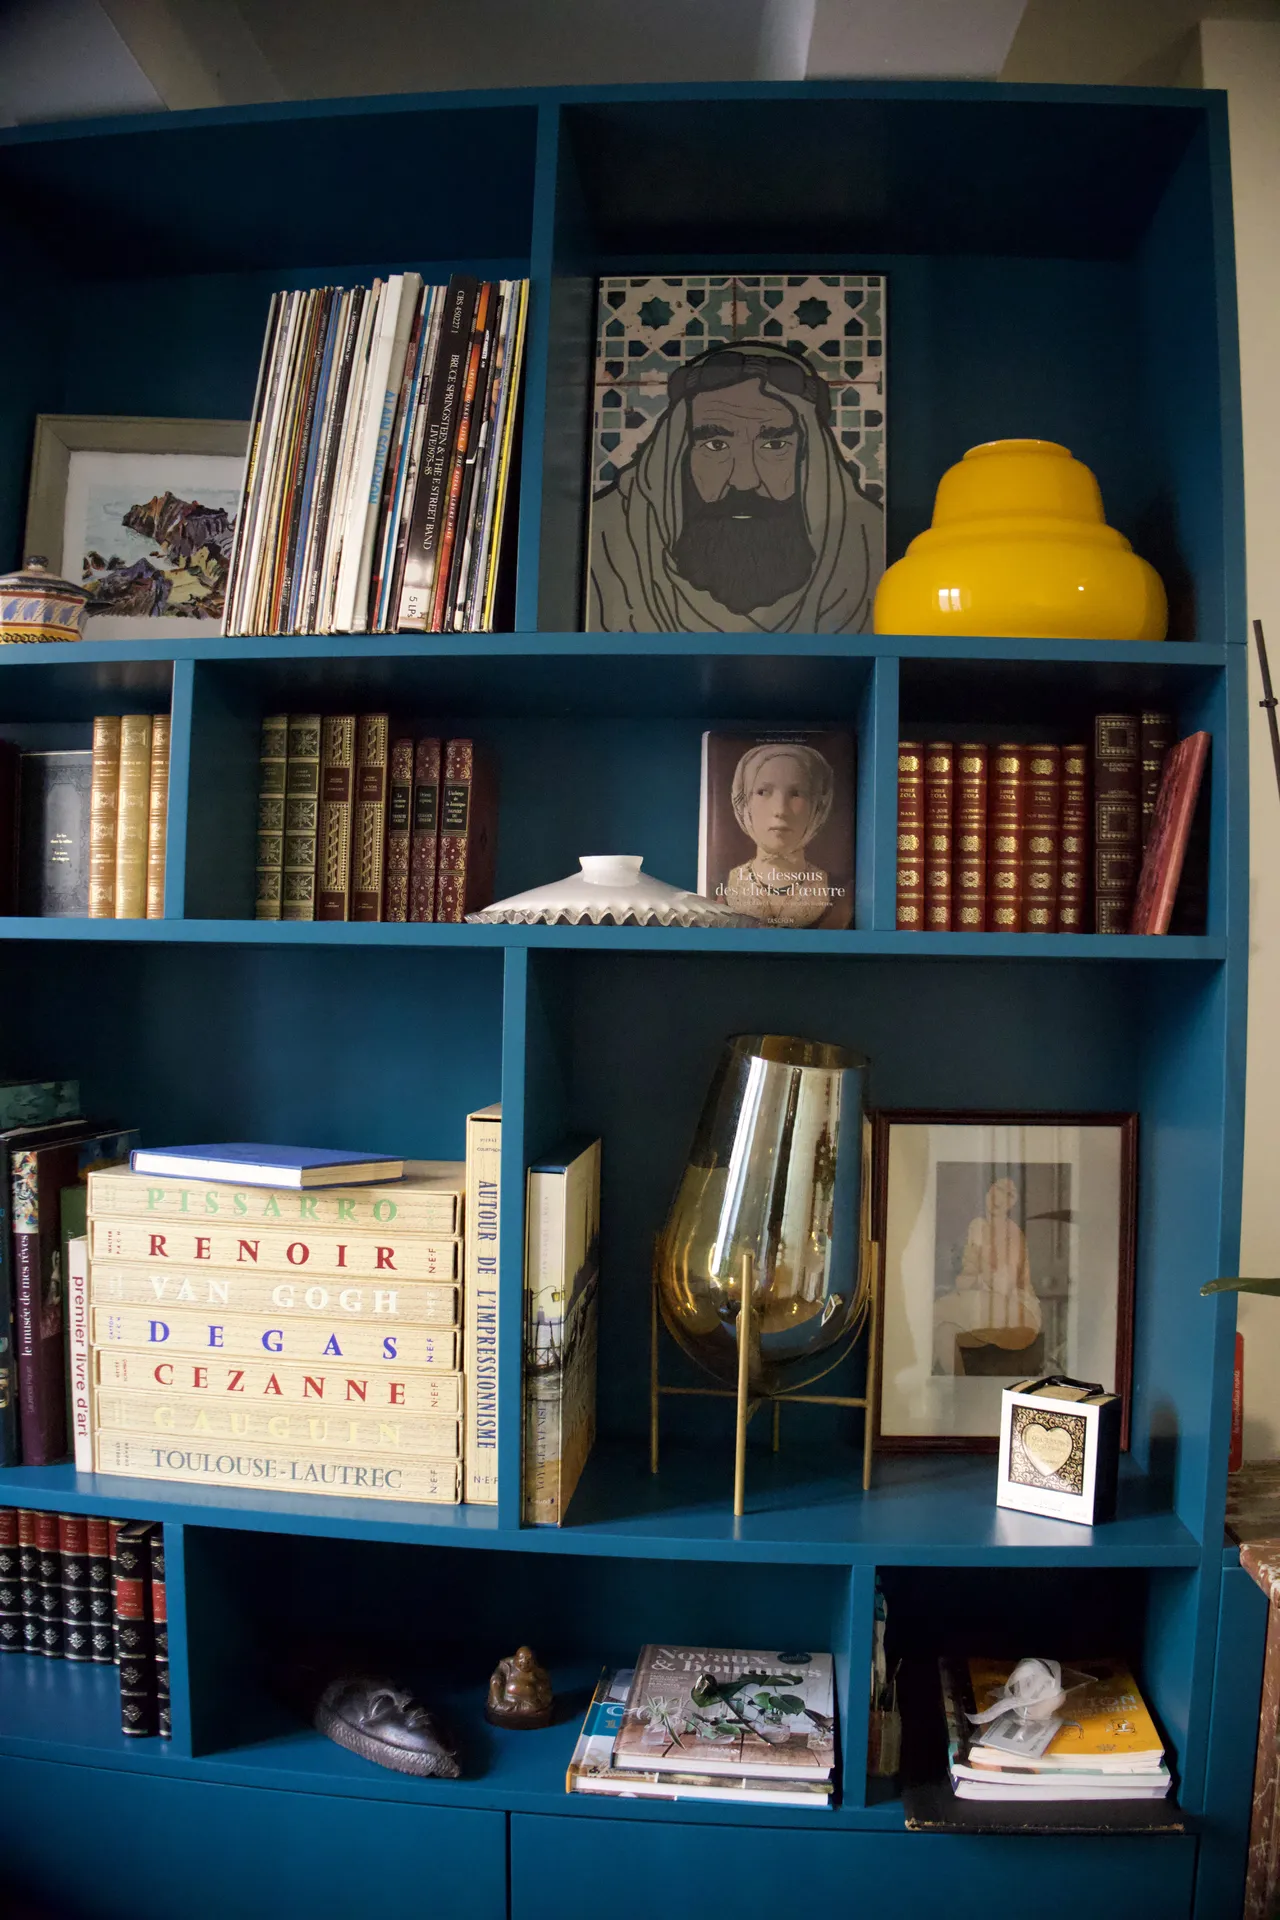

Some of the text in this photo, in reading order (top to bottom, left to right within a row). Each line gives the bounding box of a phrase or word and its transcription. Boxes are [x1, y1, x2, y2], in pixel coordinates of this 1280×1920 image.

[455, 290, 464, 305] CBS
[451, 305, 461, 329] 450227
[446, 353, 459, 383] BRUCE
[437, 383, 454, 445] SPRINGSTEEN
[462, 393, 471, 424] MONKEYS
[368, 389, 396, 504] ALAIN SOUCHON
[435, 446, 444, 455] &
[457, 444, 463, 452] AT
[432, 455, 443, 477] THE
[452, 470, 460, 491] ROYAL
[425, 485, 439, 521] STREET
[448, 493, 456, 518] ALBERT
[421, 523, 433, 550] BAND
[406, 604, 416, 618] LPs
[715, 883, 738, 896] des
[739, 868, 822, 881] Les dessous
[147, 1188, 398, 1223] PISSARRO
[149, 1234, 398, 1271] RENOIR
[18, 1235, 32, 1356] le musée de mes rêves
[149, 1276, 400, 1314] VAN GOGH
[476, 1180, 498, 1449] AUTOUR DE L'IMPRESSIONNISME
[148, 1320, 398, 1360] DEGAS
[72, 1275, 88, 1437] premier livre d'art
[154, 1364, 406, 1406] CEZANNE
[153, 1406, 401, 1446] GAUGUIN
[152, 1448, 402, 1489] TOULOUSE-LAUTREC
[651, 1659, 676, 1672] &
